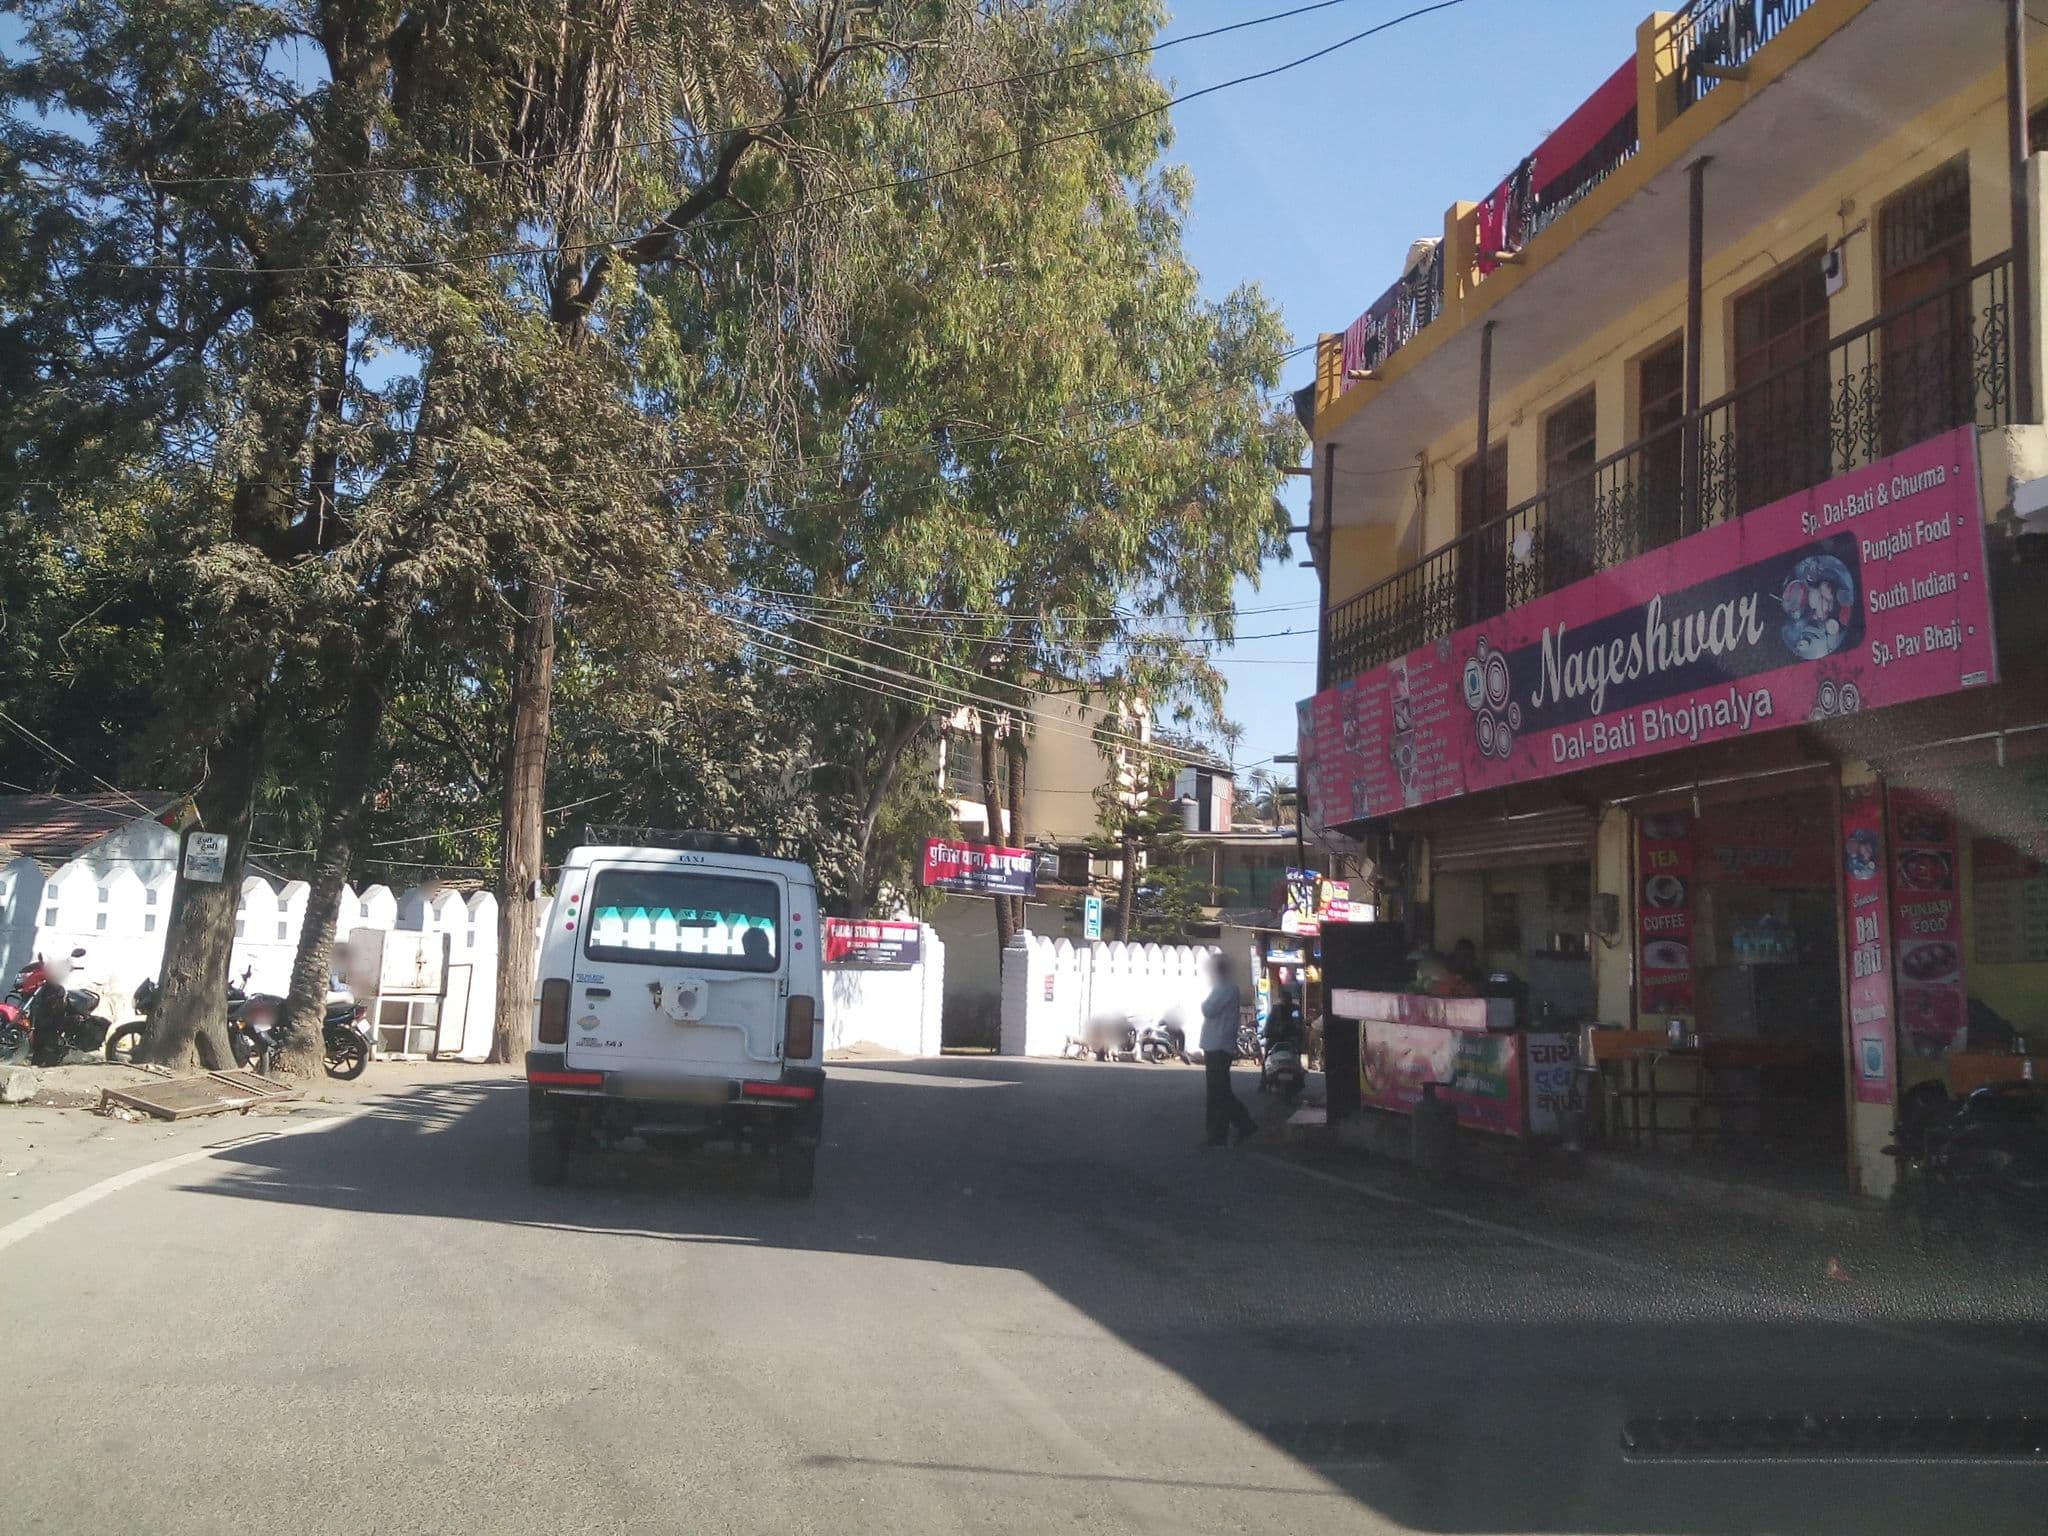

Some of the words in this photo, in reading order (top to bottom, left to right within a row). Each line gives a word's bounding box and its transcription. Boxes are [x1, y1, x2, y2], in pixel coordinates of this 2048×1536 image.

[1801, 510, 1822, 536] Sp.
[1823, 486, 1874, 526] Dal-Bati
[1877, 482, 1889, 506] &
[1891, 463, 1946, 501] Churma
[1862, 524, 1913, 563] Punjabi
[1915, 511, 1951, 546] Food
[1869, 582, 1910, 614] South
[1912, 570, 1957, 602] Indian
[1531, 591, 1765, 716] Nageshwar
[1871, 639, 1894, 668] Sp.
[1895, 633, 1921, 659] Pav
[1923, 618, 1962, 652] Bhaji
[1551, 713, 1637, 763] Dal-Bati
[1641, 687, 1773, 744] Bhojnalya
[929, 843, 961, 867] पुलिस
[1648, 849, 1680, 868] TEA
[1643, 912, 1686, 930] COFFEE
[1899, 898, 1953, 918] PUNJABI
[1855, 911, 1880, 944] Dal
[1911, 917, 1949, 935] FOOD
[1852, 944, 1882, 979] Bati
